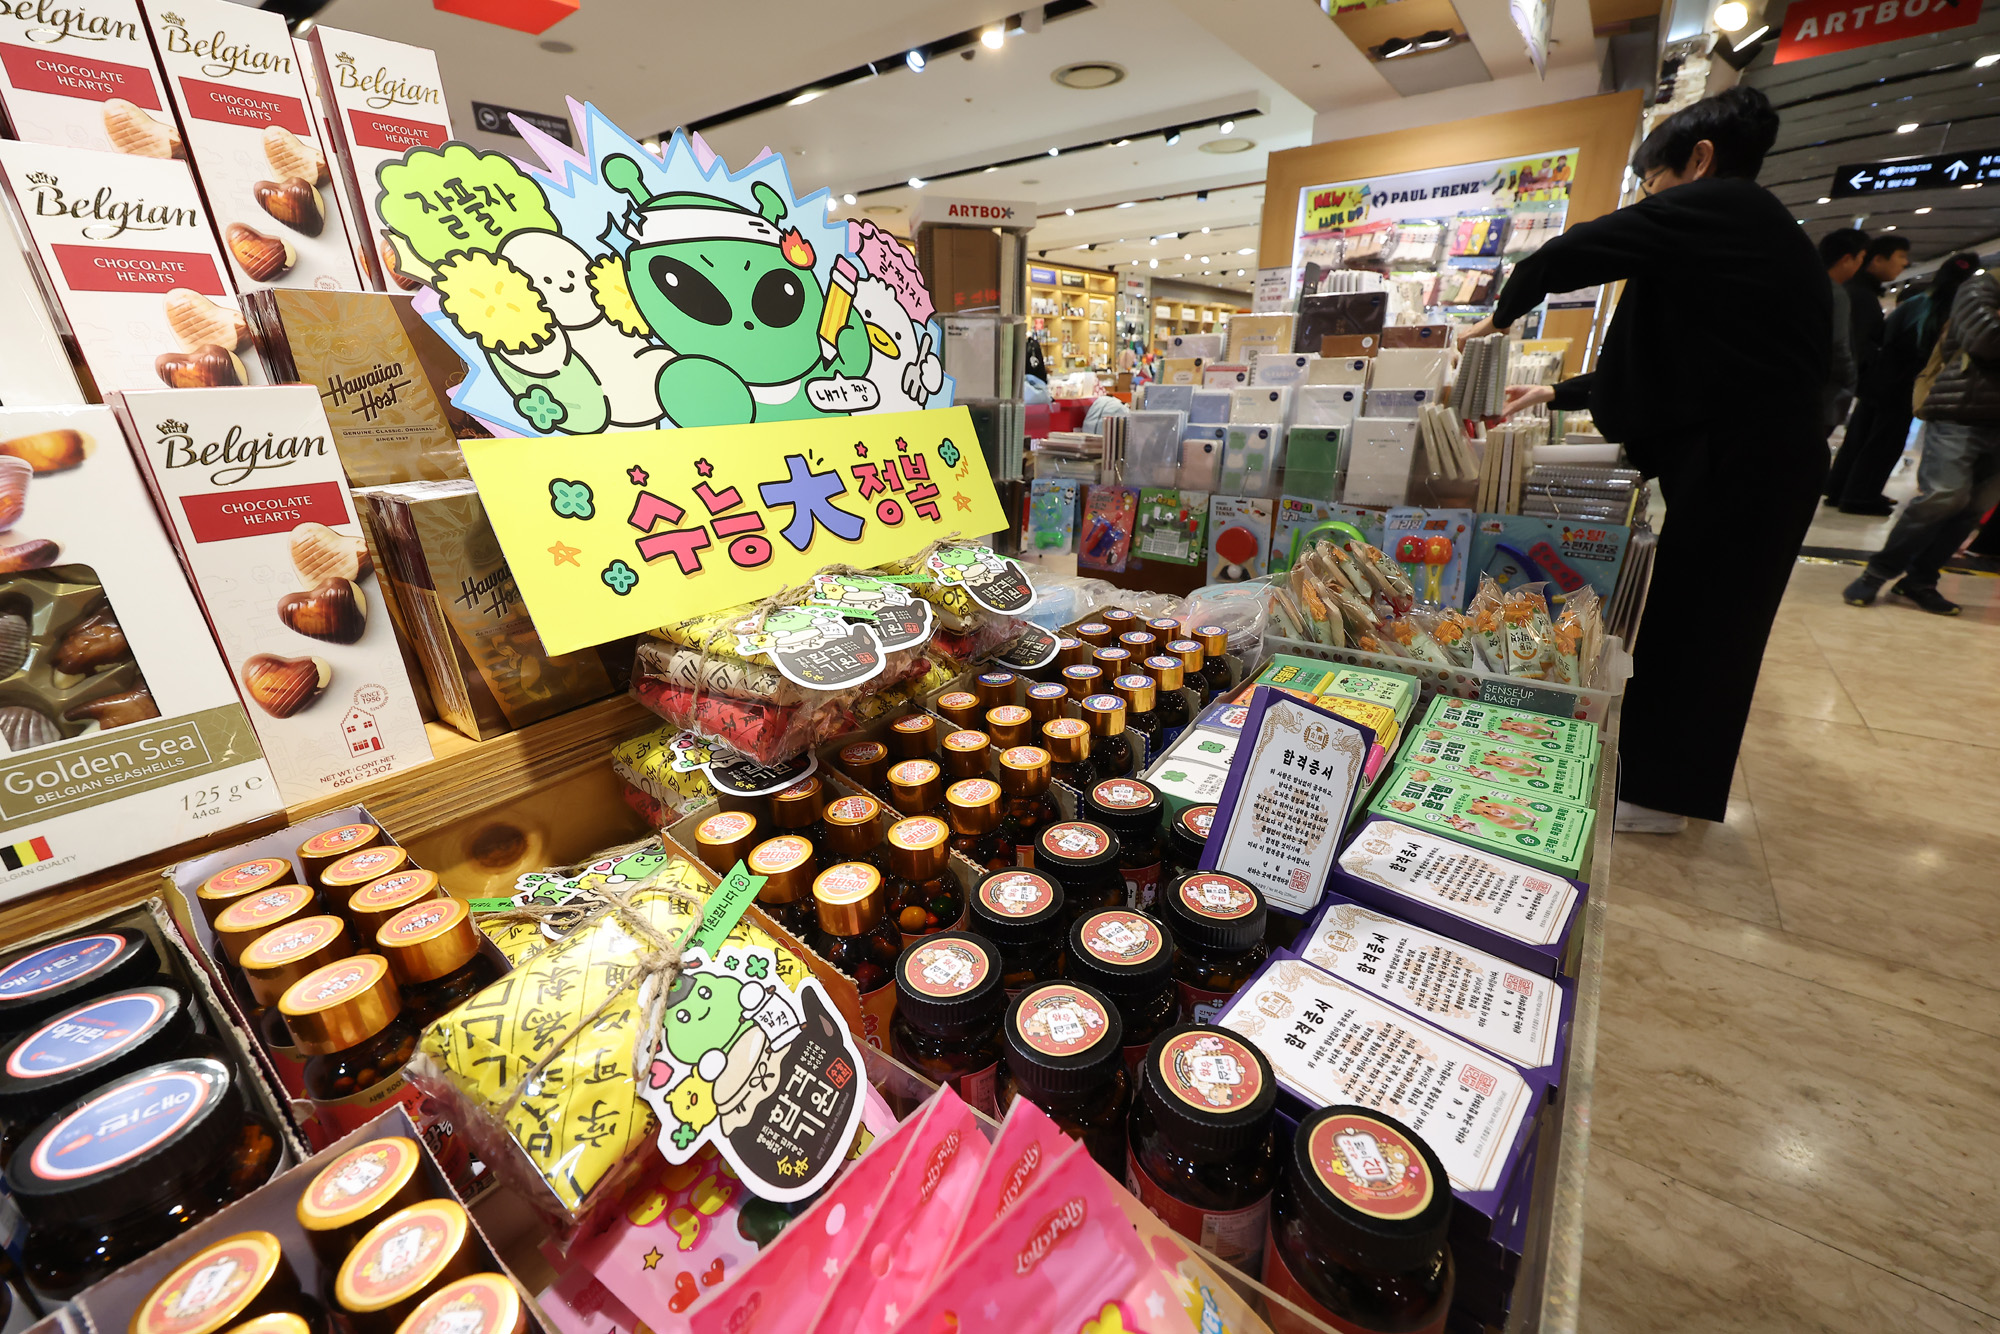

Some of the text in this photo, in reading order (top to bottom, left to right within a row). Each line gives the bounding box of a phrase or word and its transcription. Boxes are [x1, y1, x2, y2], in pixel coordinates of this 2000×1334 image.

[1794, 0, 1949, 41] ARTBO
[165, 25, 293, 77] Belgian
[35, 58, 126, 85] CHOCOLATE
[56, 74, 114, 94] HEARTS
[337, 62, 440, 109] Belgian
[209, 91, 281, 114] CHOCOLATE
[226, 103, 272, 122] HEARTS
[372, 121, 430, 139] CHOCOLATE
[385, 133, 422, 147] HEARTS
[1313, 192, 1346, 210] NEW
[1391, 181, 1480, 204] PAUL FRENZ
[31, 187, 199, 240] Belgian
[404, 177, 517, 239] 잘풀자
[948, 203, 1014, 219] ARTBOX
[93, 256, 187, 274] CHOCOLATE
[116, 268, 176, 285] HEARTS
[321, 363, 404, 407] Hawaiian
[816, 383, 868, 402] 내가 짱
[351, 380, 412, 422] Host
[158, 424, 329, 486] Belgian
[220, 494, 313, 516] CHOCOLATE
[243, 507, 301, 525] HEARTS
[627, 452, 943, 577] 수능 大 정복
[807, 645, 848, 664] 합격
[821, 656, 861, 672] 기원
[360, 691, 380, 699] SINCE
[362, 697, 381, 705] 1956
[1484, 693, 1522, 707] BASKET
[1486, 685, 1534, 700] SENSE-UP
[3, 731, 198, 796] Golden Sea
[320, 755, 397, 783] NET WT. CONT. NET.
[333, 763, 393, 788] 65G 2.3OZ
[1283, 749, 1334, 781] 합격증서
[34, 755, 186, 806] BELGIAN SEASHELLS
[179, 785, 222, 813] 125
[191, 807, 222, 820] 4.4 OZ
[902, 822, 939, 846] 부터500
[37, 855, 78, 875] QUALITY
[755, 851, 801, 862] 부터500
[1389, 842, 1422, 872] 합격증서
[819, 876, 869, 890] 부터500
[697, 890, 738, 933] 기원합니다
[1356, 932, 1389, 975] 합격증서
[759, 1010, 789, 1028] 합격
[1284, 998, 1334, 1050] 합격증서
[768, 1064, 817, 1133] 합격
[793, 1080, 840, 1141] 기원
[776, 1155, 809, 1178] 合格
[920, 1130, 960, 1199] LollyPolly
[996, 1143, 1039, 1219] ollyPolly
[1016, 1198, 1084, 1275] LollyPolly
